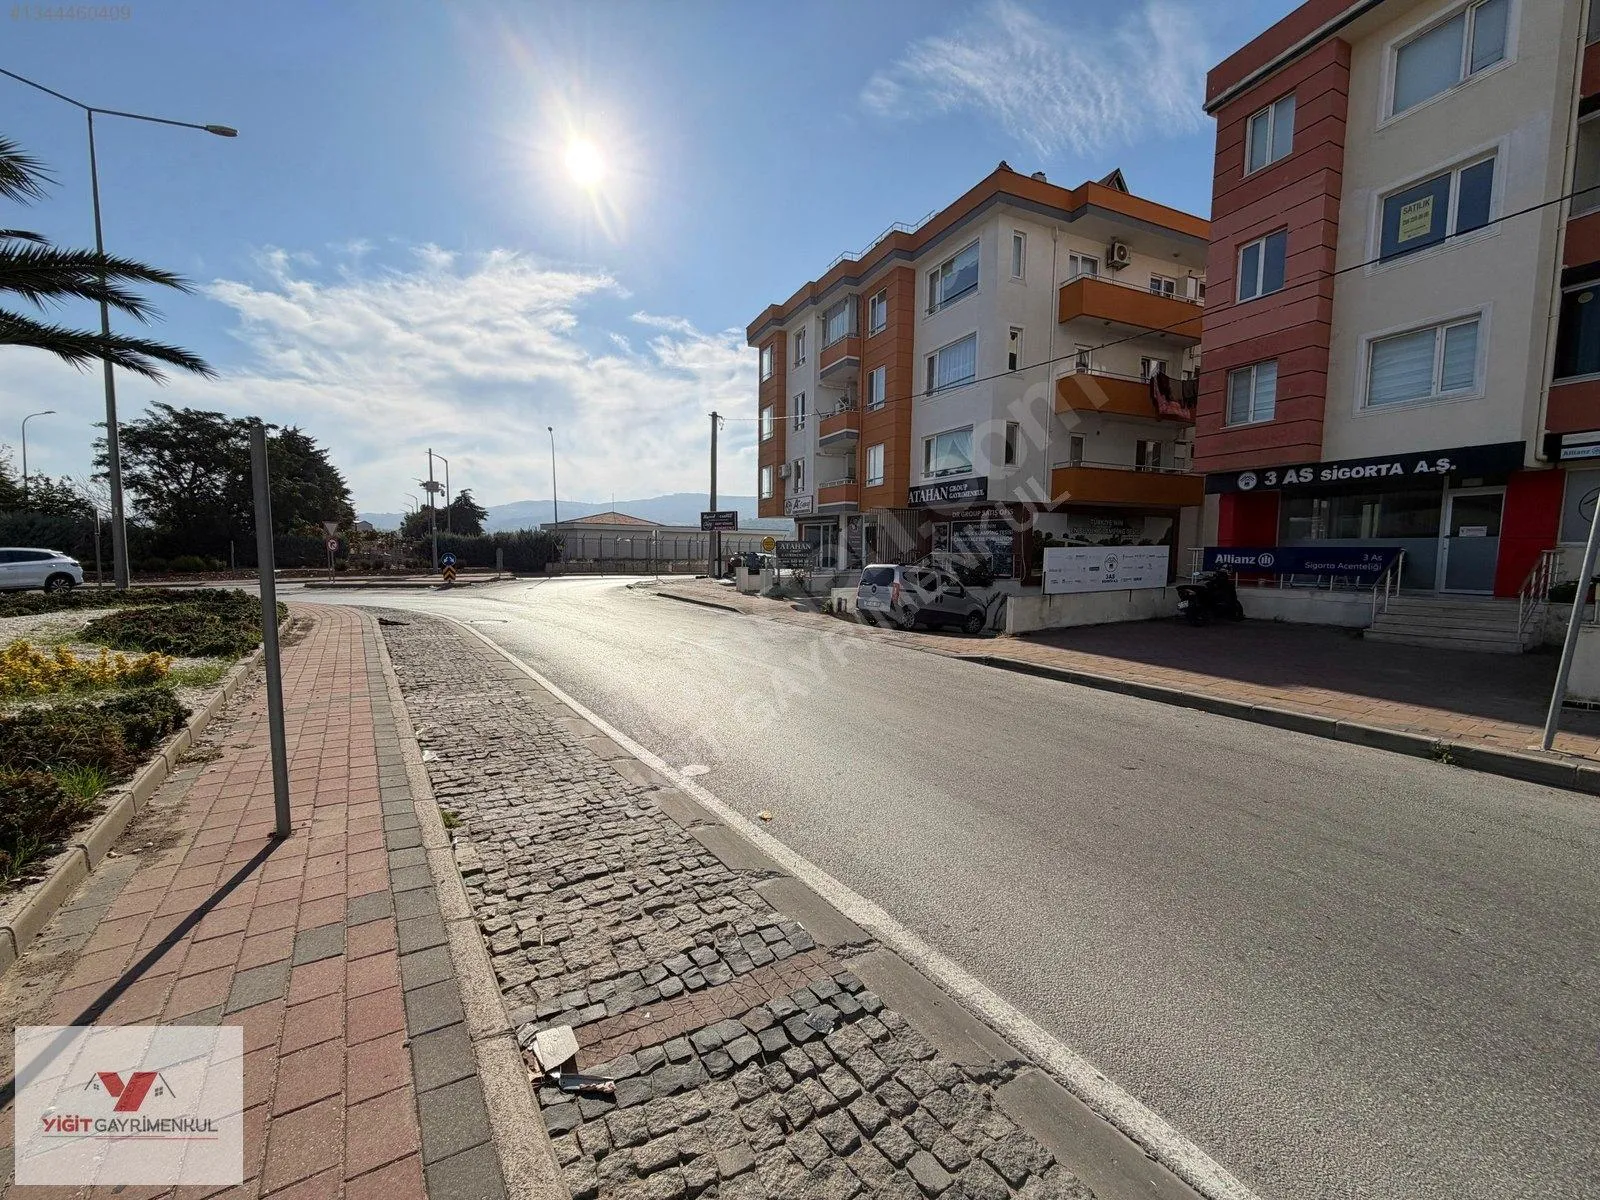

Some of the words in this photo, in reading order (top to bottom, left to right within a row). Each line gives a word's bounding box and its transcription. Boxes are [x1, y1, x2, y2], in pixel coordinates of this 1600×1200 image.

[1403, 199, 1430, 215] SATILIK
[1265, 471, 1277, 485] 3
[1282, 468, 1313, 484] AS
[1413, 458, 1456, 474] A.Ş.
[949, 484, 968, 492] GROUP
[908, 487, 948, 503] ATAHAN
[1214, 554, 1256, 565] Allianz
[1363, 554, 1369, 562] 3
[1371, 554, 1383, 562] As
[1304, 562, 1335, 571] Sigorta
[1338, 562, 1382, 571] Acenteliği
